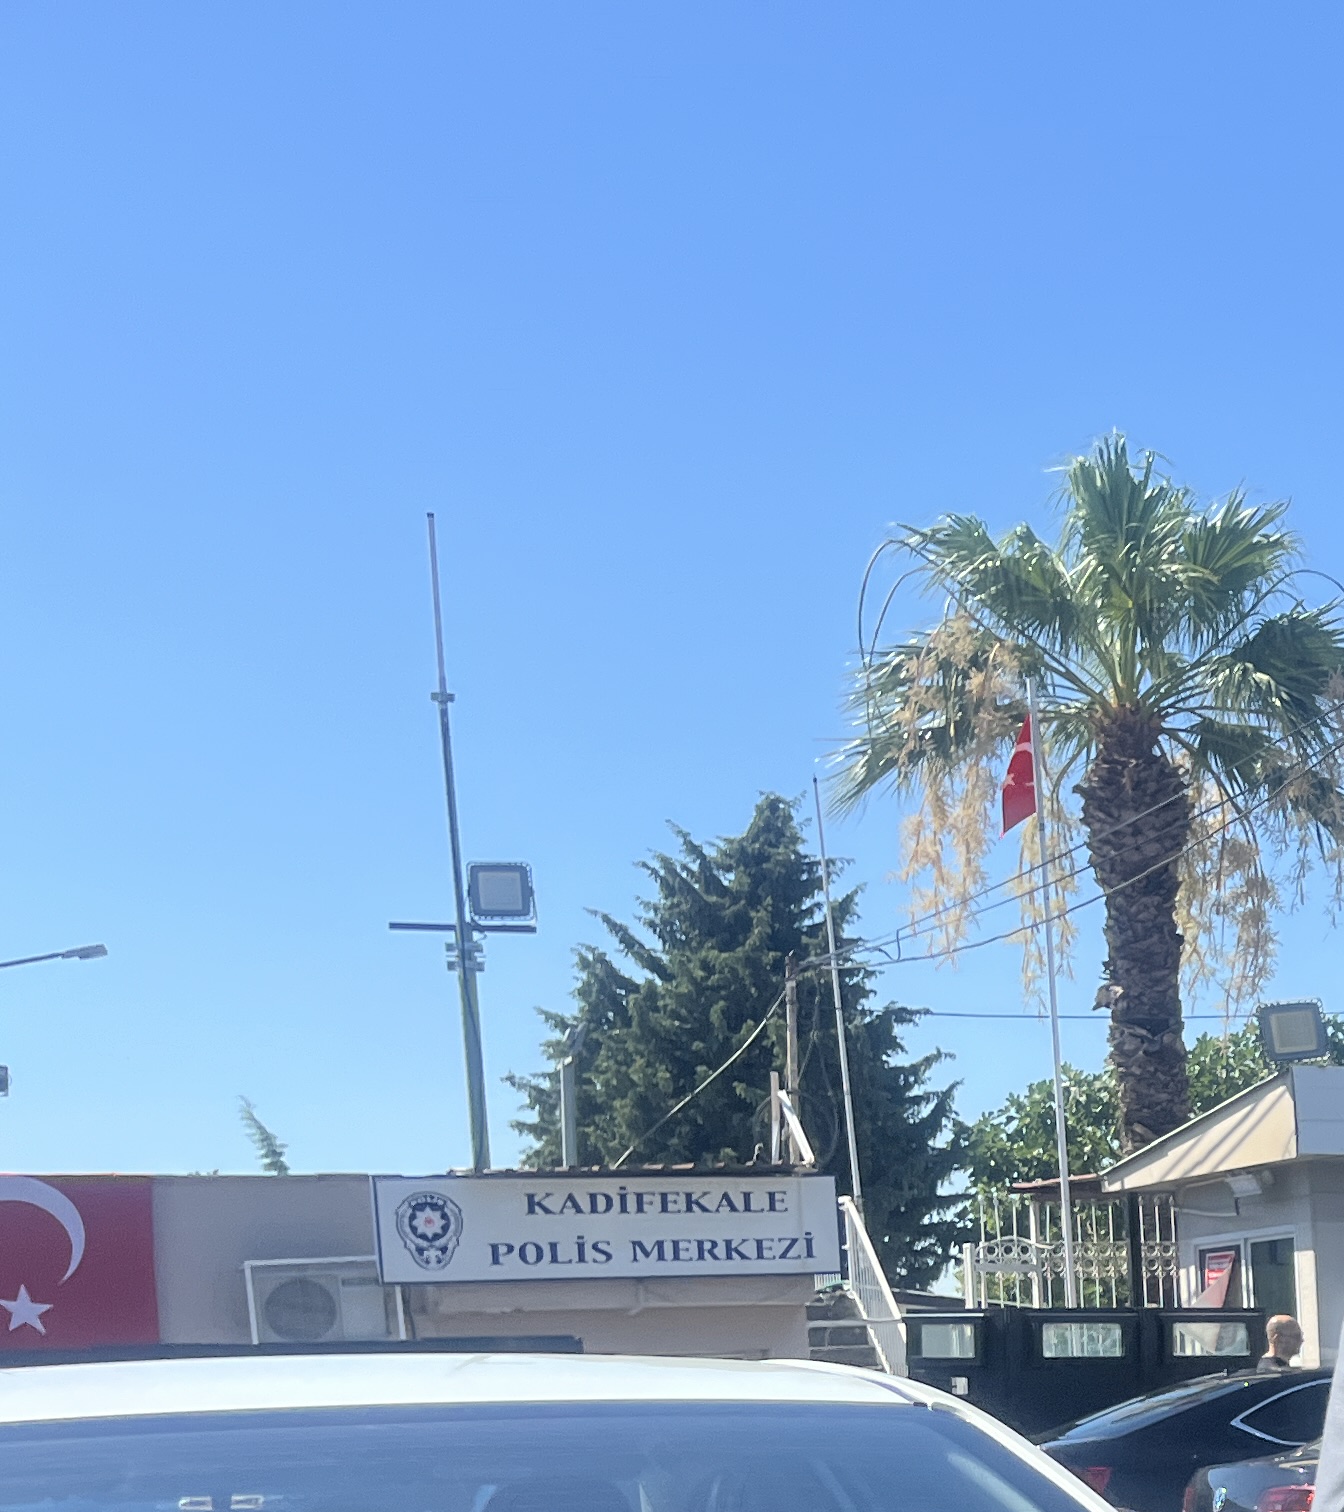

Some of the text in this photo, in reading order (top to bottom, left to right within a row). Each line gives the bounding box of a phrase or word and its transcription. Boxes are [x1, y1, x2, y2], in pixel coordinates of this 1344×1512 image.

[526, 1186, 788, 1217] KADİFEKALE
[489, 1232, 817, 1267] POLİS MERKEZİ
